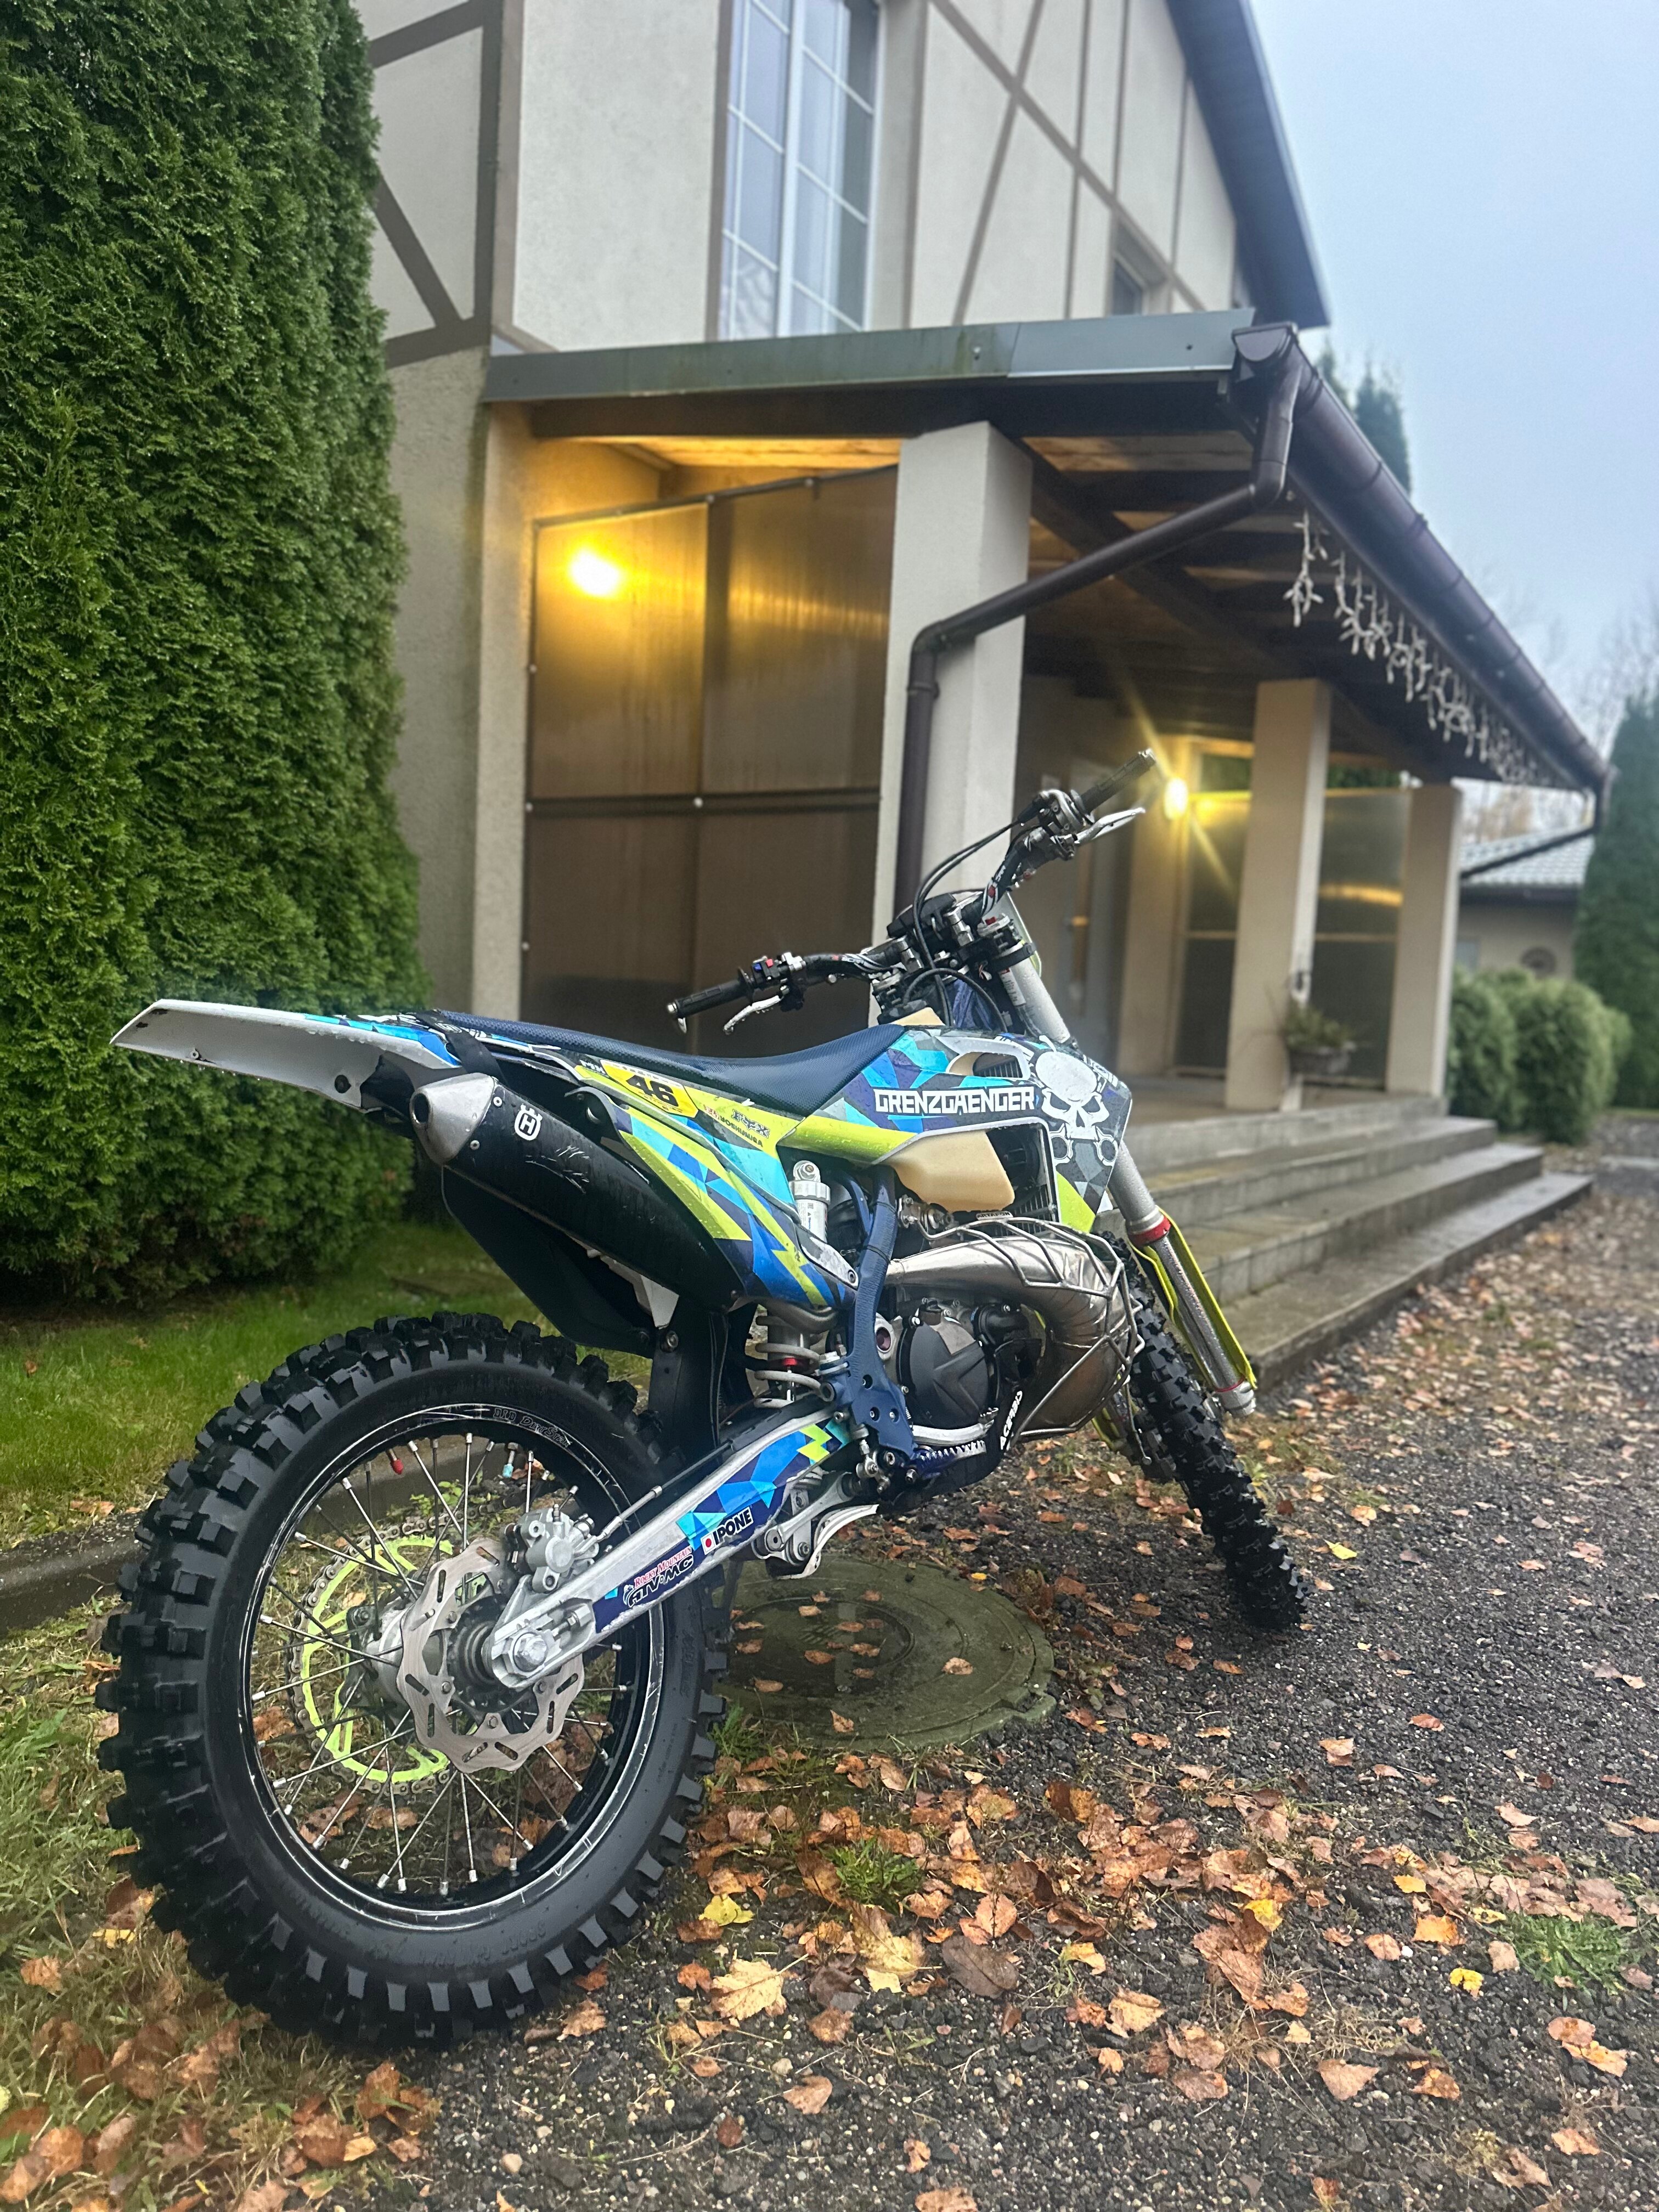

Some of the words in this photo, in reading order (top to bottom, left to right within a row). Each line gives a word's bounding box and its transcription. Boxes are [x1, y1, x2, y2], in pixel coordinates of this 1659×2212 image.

[626, 1075, 679, 1107] 46
[873, 1086, 1035, 1114] GRENZGAENGER
[493, 1408, 516, 1421] DID
[713, 1507, 753, 1546] IPONE
[634, 1566, 657, 1588] ROCKY
[657, 1546, 692, 1573] MOUNTAIN
